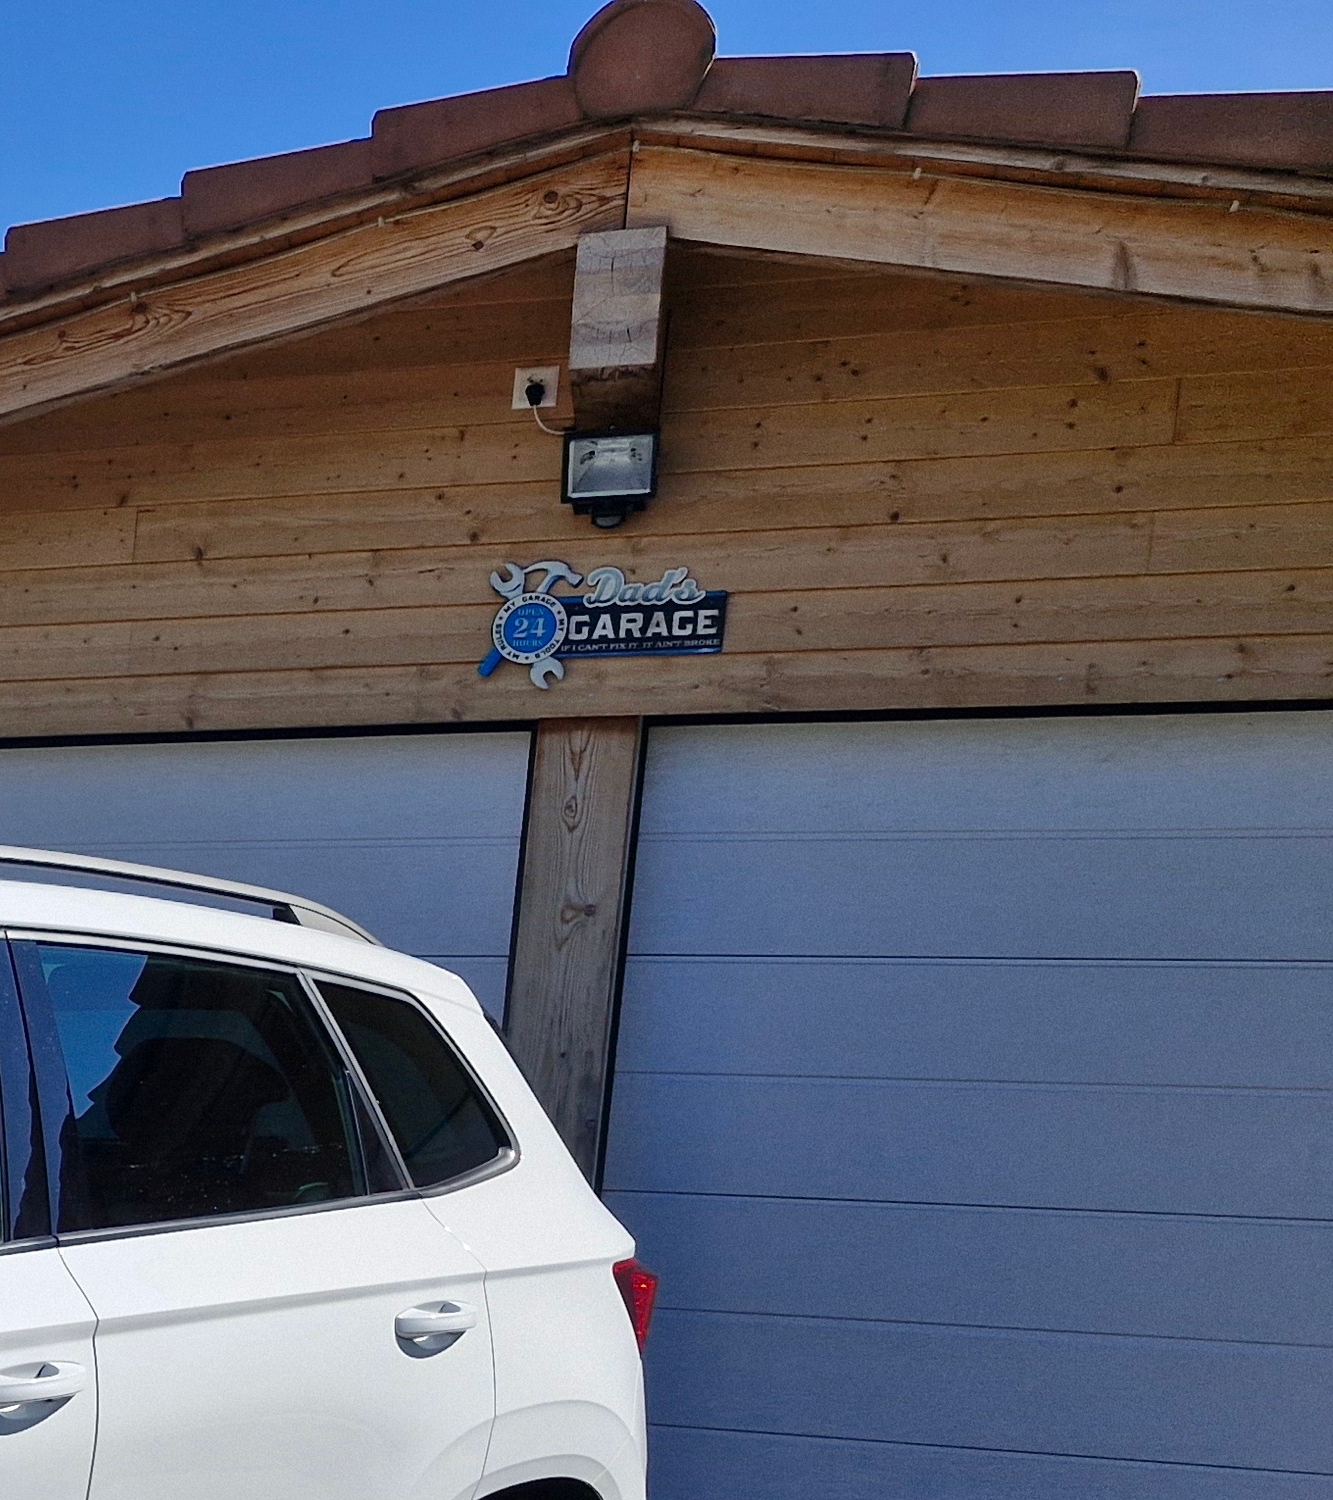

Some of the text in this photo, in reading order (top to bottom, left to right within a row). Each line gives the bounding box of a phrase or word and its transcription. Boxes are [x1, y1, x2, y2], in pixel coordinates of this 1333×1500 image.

[583, 567, 706, 608] Dad's
[503, 595, 556, 613] MY GARAGE
[518, 608, 544, 616] OPEN
[512, 617, 546, 638] 24
[568, 609, 719, 640] GARAGE
[512, 639, 543, 647] HOURS
